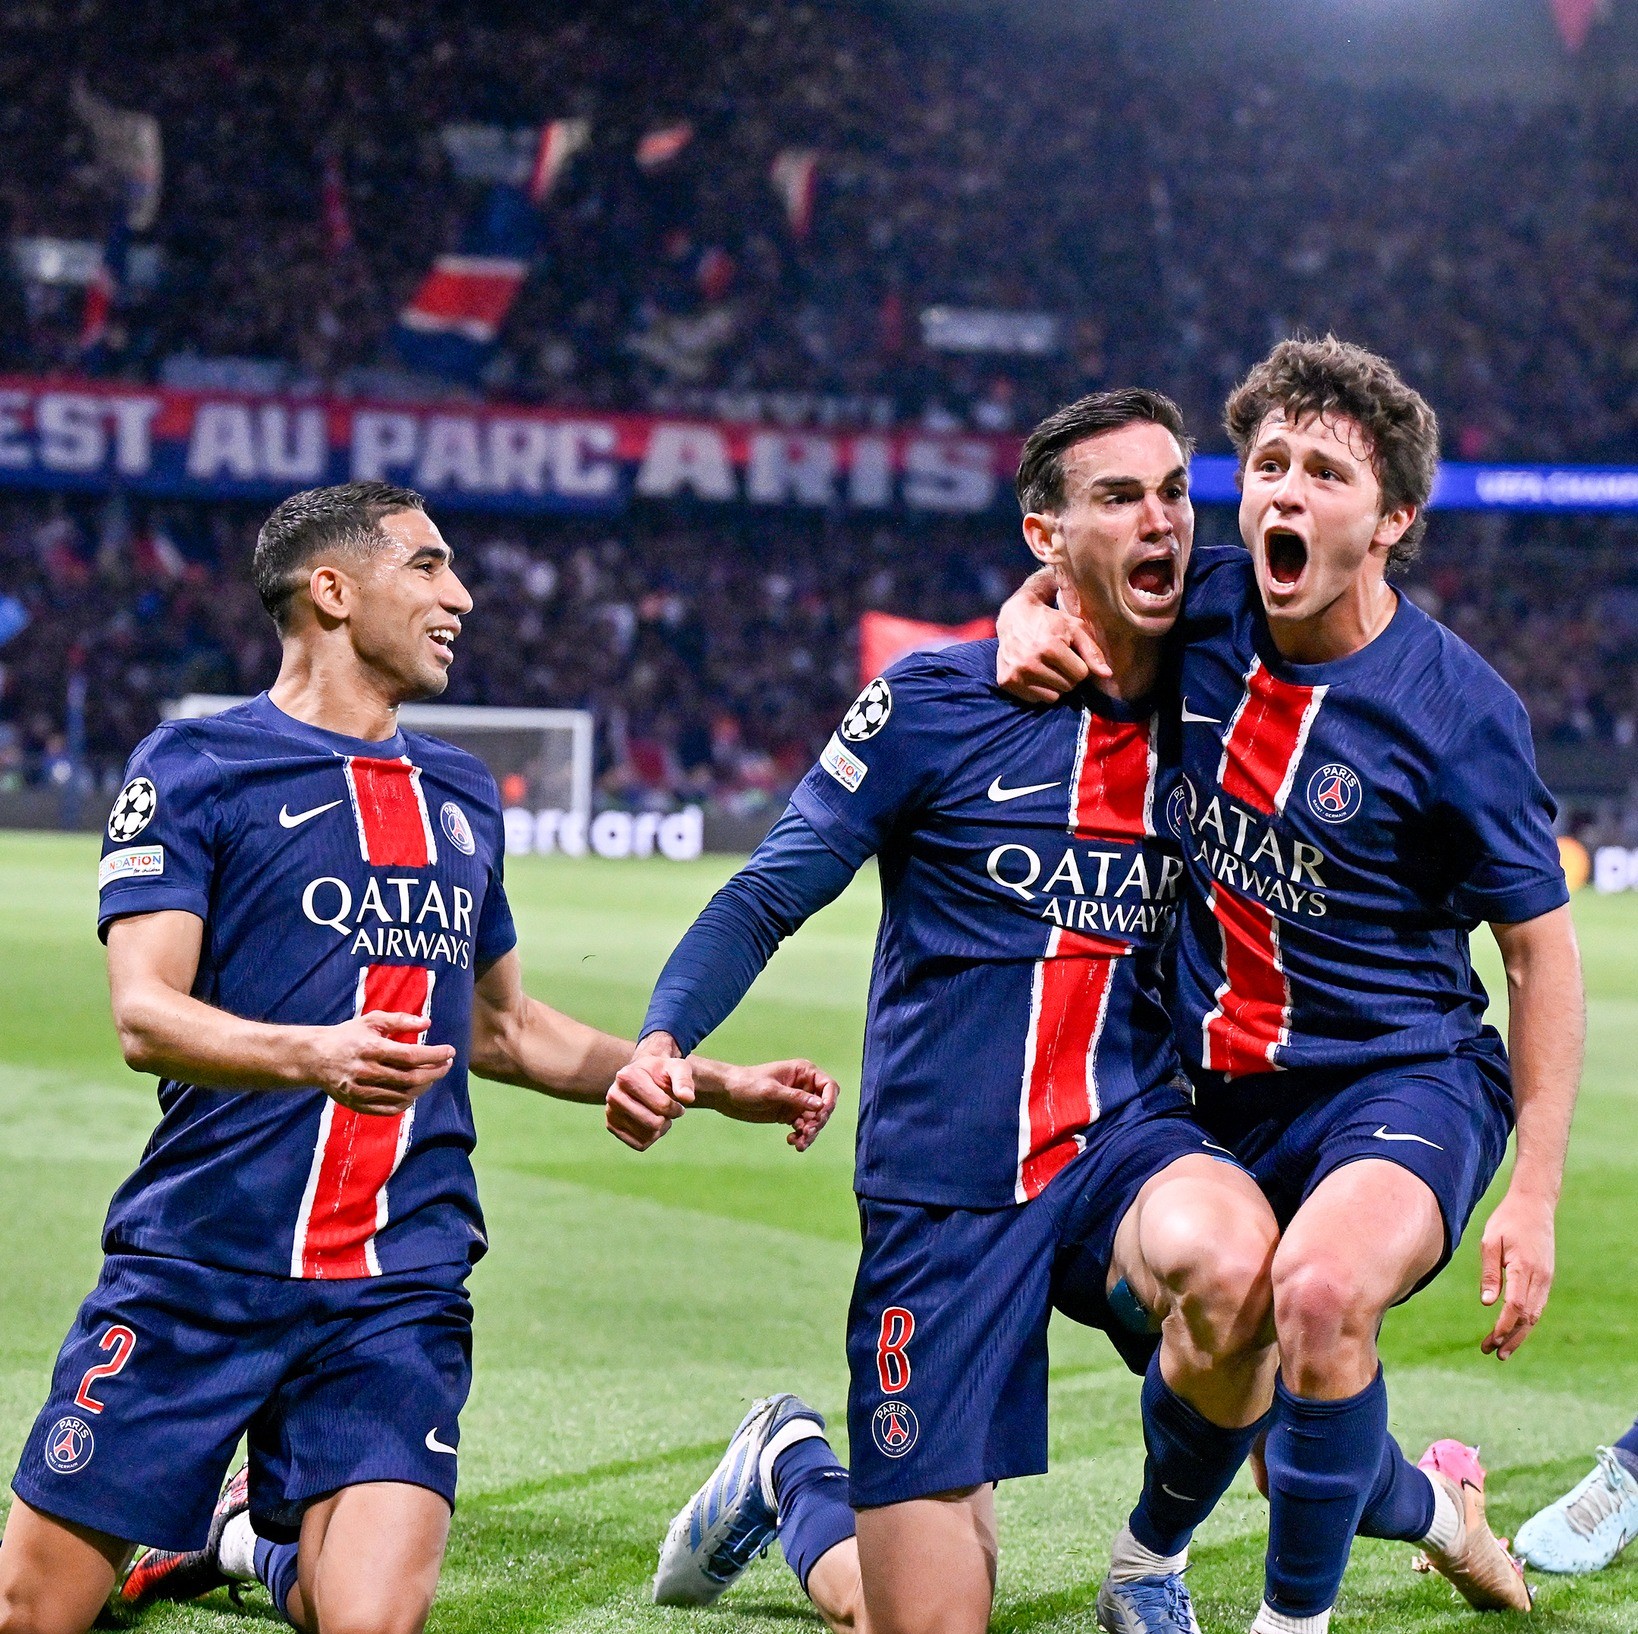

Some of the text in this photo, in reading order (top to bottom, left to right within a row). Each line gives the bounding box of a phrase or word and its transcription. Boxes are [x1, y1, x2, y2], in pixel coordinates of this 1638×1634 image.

[187, 401, 328, 481] AU
[351, 410, 618, 496] PARC
[1322, 766, 1357, 788] PARIS
[986, 843, 1184, 901] QATAR
[1192, 839, 1328, 917] AIRWAYS
[301, 876, 474, 937] QATAR
[350, 927, 470, 970] AIRWAYS
[73, 1324, 137, 1415] 2
[876, 1306, 916, 1395] 8
[59, 1419, 90, 1439] PARIS
[876, 1403, 908, 1420] PARIS
